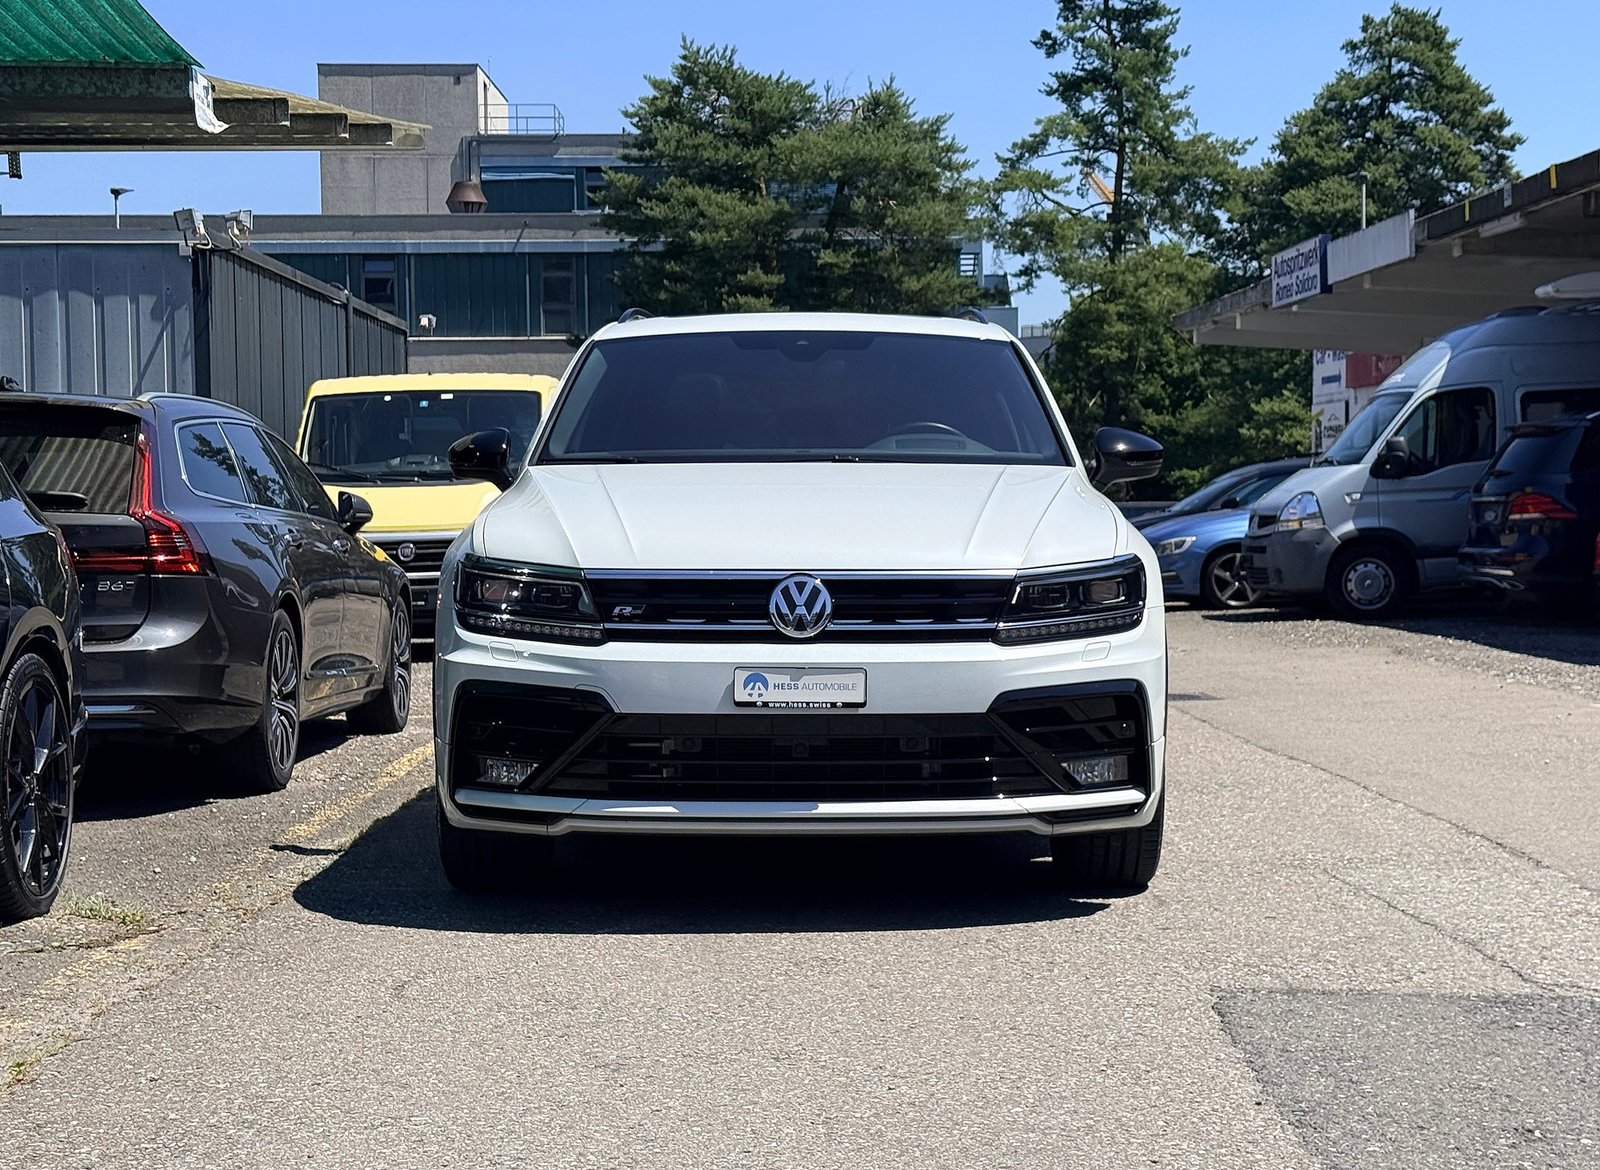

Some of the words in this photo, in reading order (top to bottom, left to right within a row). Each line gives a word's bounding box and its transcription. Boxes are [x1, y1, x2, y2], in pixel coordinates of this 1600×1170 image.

[1274, 240, 1320, 280] Autospritzwerk
[1275, 282, 1294, 303] Romeo
[773, 682, 800, 691] HESS
[801, 682, 858, 691] AUTOMOBILE
[767, 701, 832, 709] www.hess.swiss
